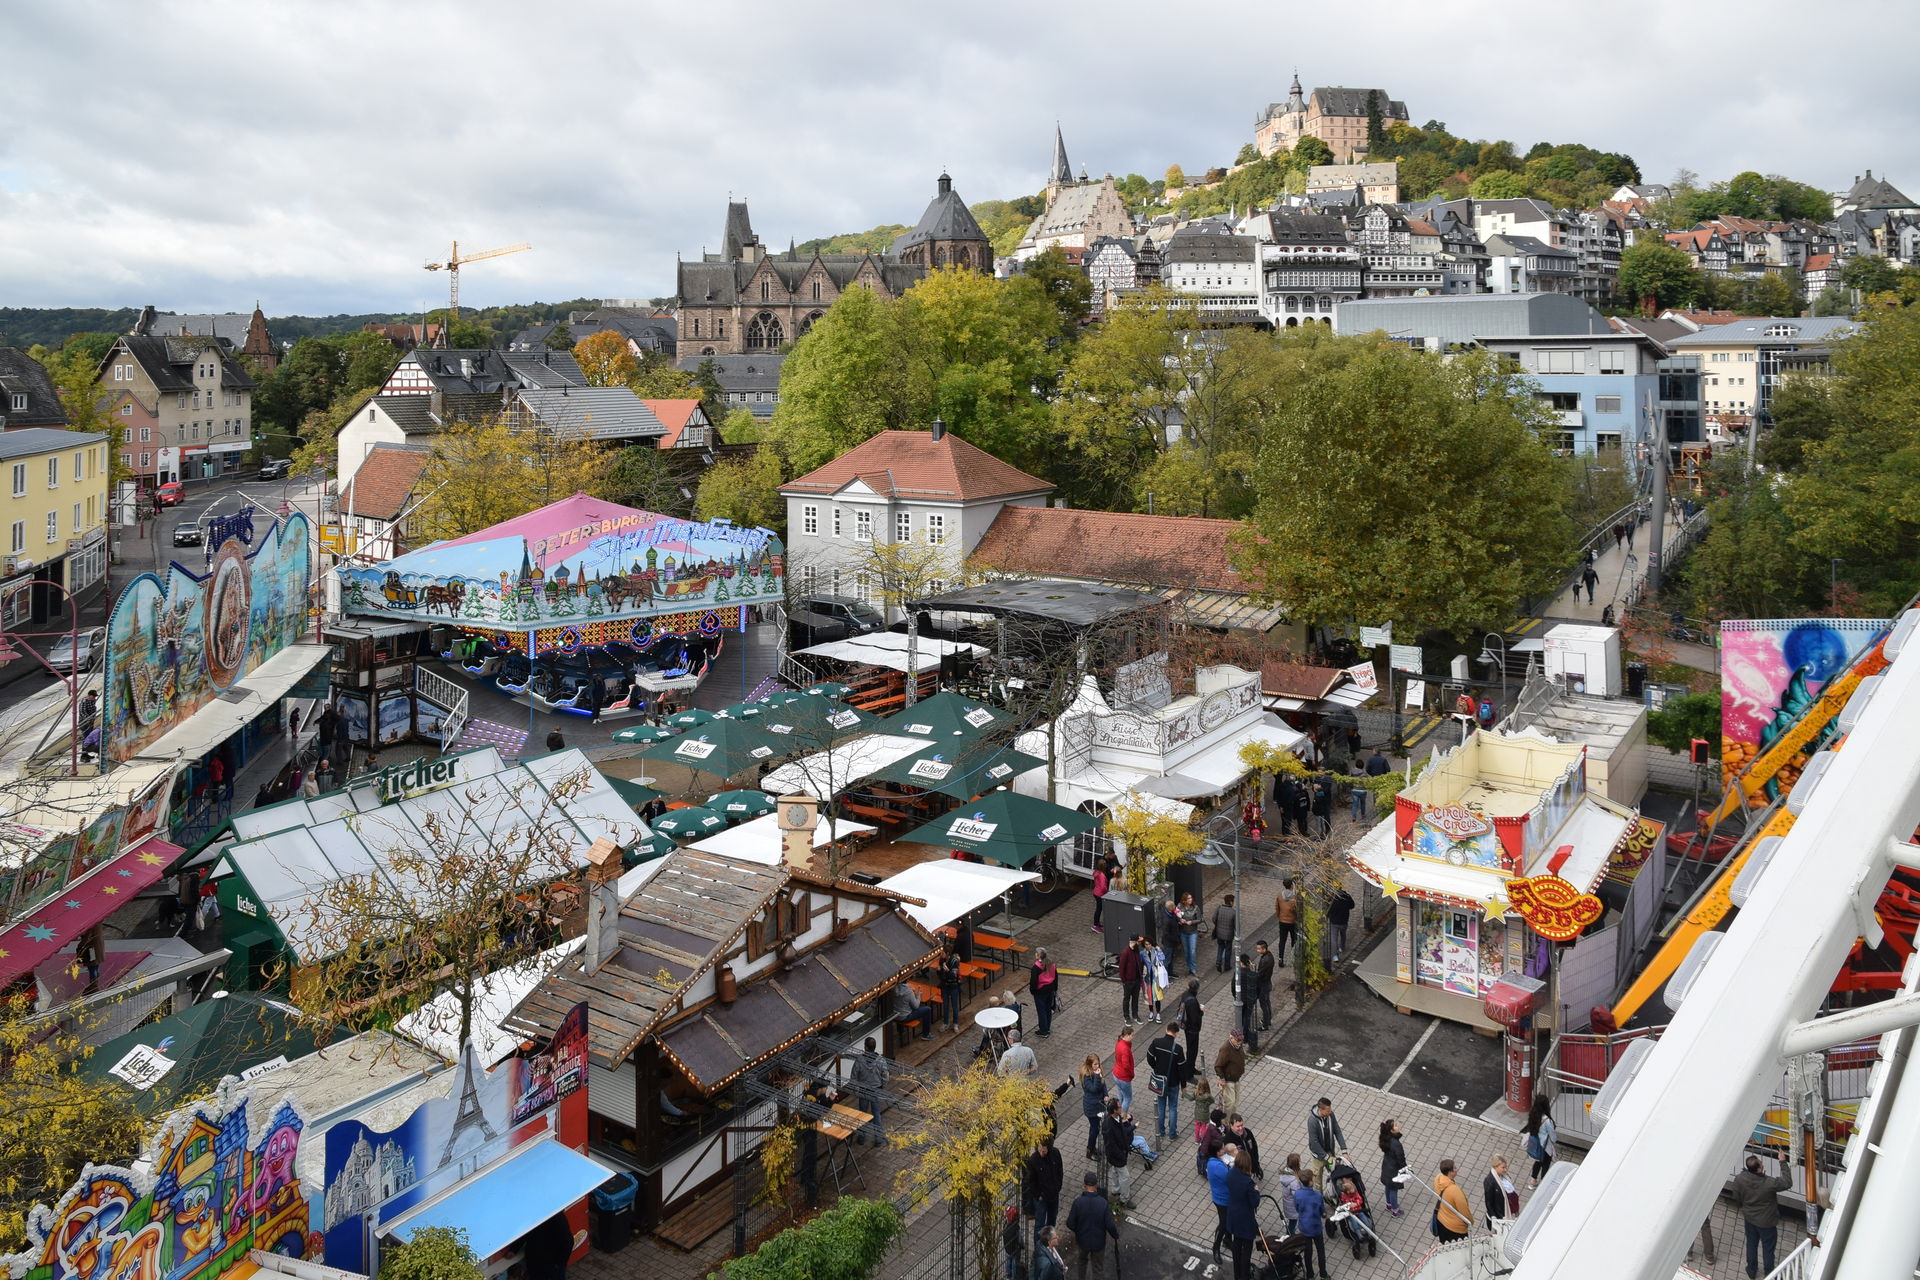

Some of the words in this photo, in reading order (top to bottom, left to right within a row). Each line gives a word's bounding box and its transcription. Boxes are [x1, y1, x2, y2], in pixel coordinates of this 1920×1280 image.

[532, 511, 656, 561] PETERSBURGER
[682, 742, 708, 755] Licher
[916, 762, 944, 775] Licher
[1433, 807, 1470, 820] CIRCUS
[956, 821, 987, 836] Licher
[1444, 820, 1478, 832] CIRCUS
[1315, 1057, 1343, 1072] 32
[1437, 1094, 1467, 1110] 33
